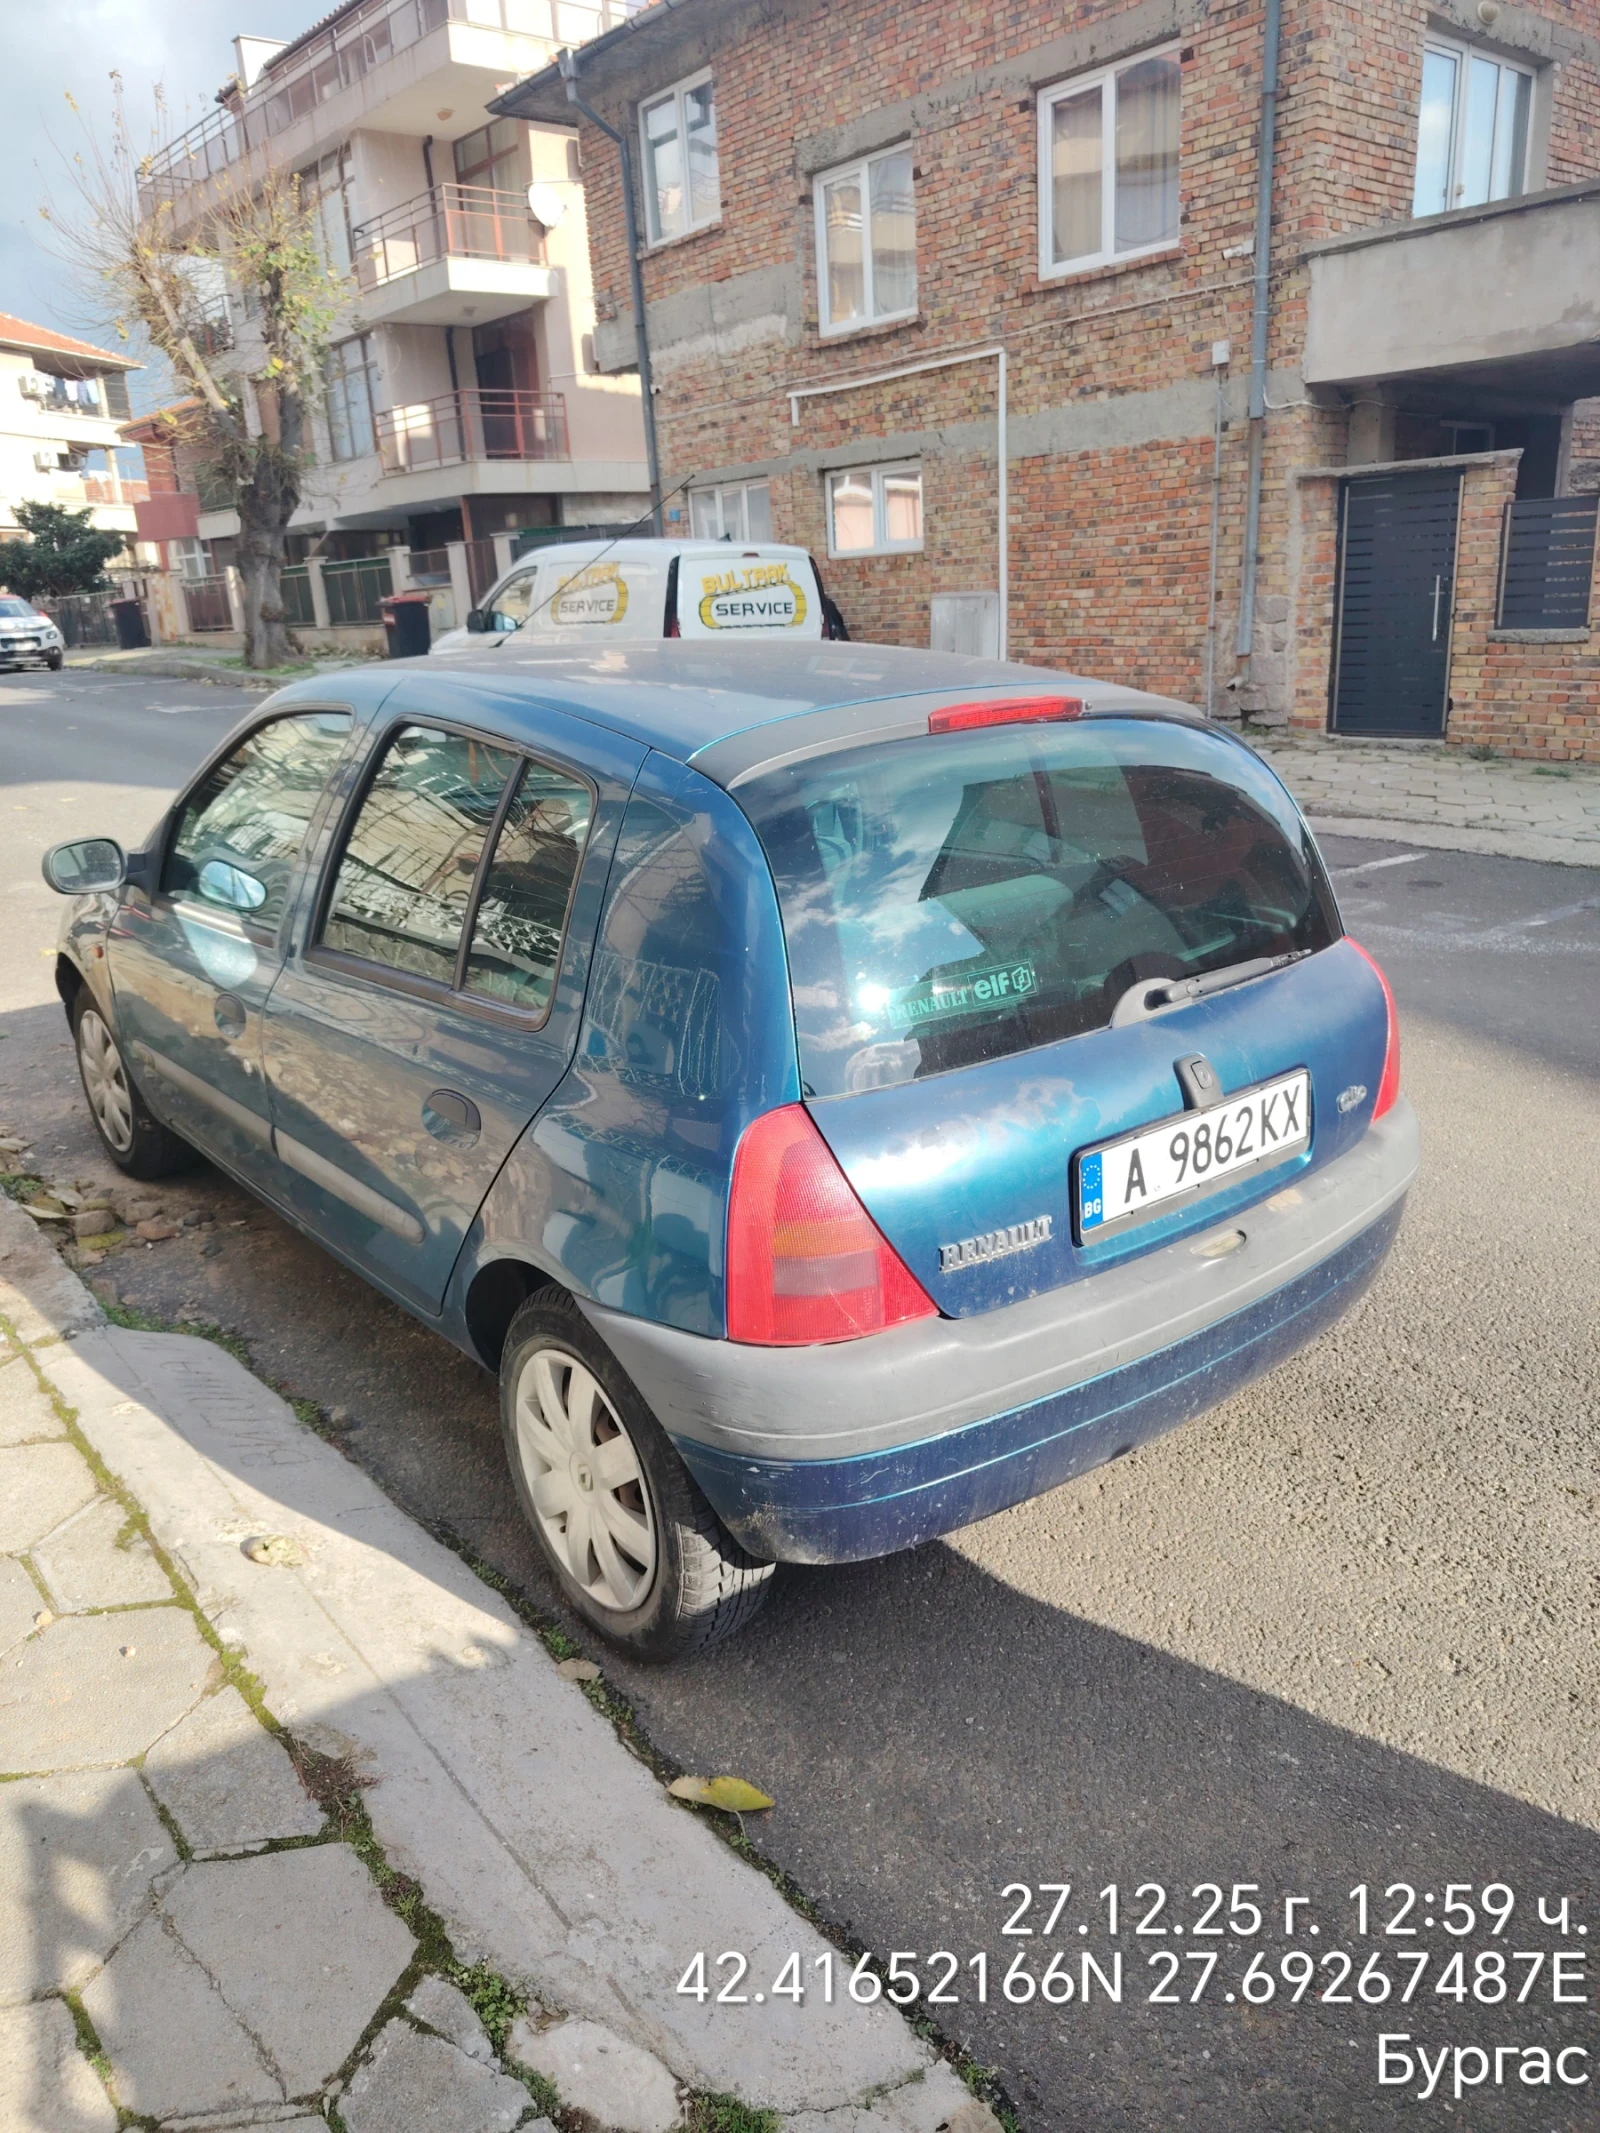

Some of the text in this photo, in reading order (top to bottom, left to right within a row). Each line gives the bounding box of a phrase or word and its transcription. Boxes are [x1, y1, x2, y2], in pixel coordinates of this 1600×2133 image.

[700, 563, 790, 595] BULTRAK
[560, 599, 615, 614] SERVICE
[715, 602, 793, 617] SERVICE
[973, 971, 1010, 1000] elf
[1124, 1147, 1147, 1204] A
[1084, 1198, 1102, 1219] BG
[938, 1214, 1053, 1273] RENAULT
